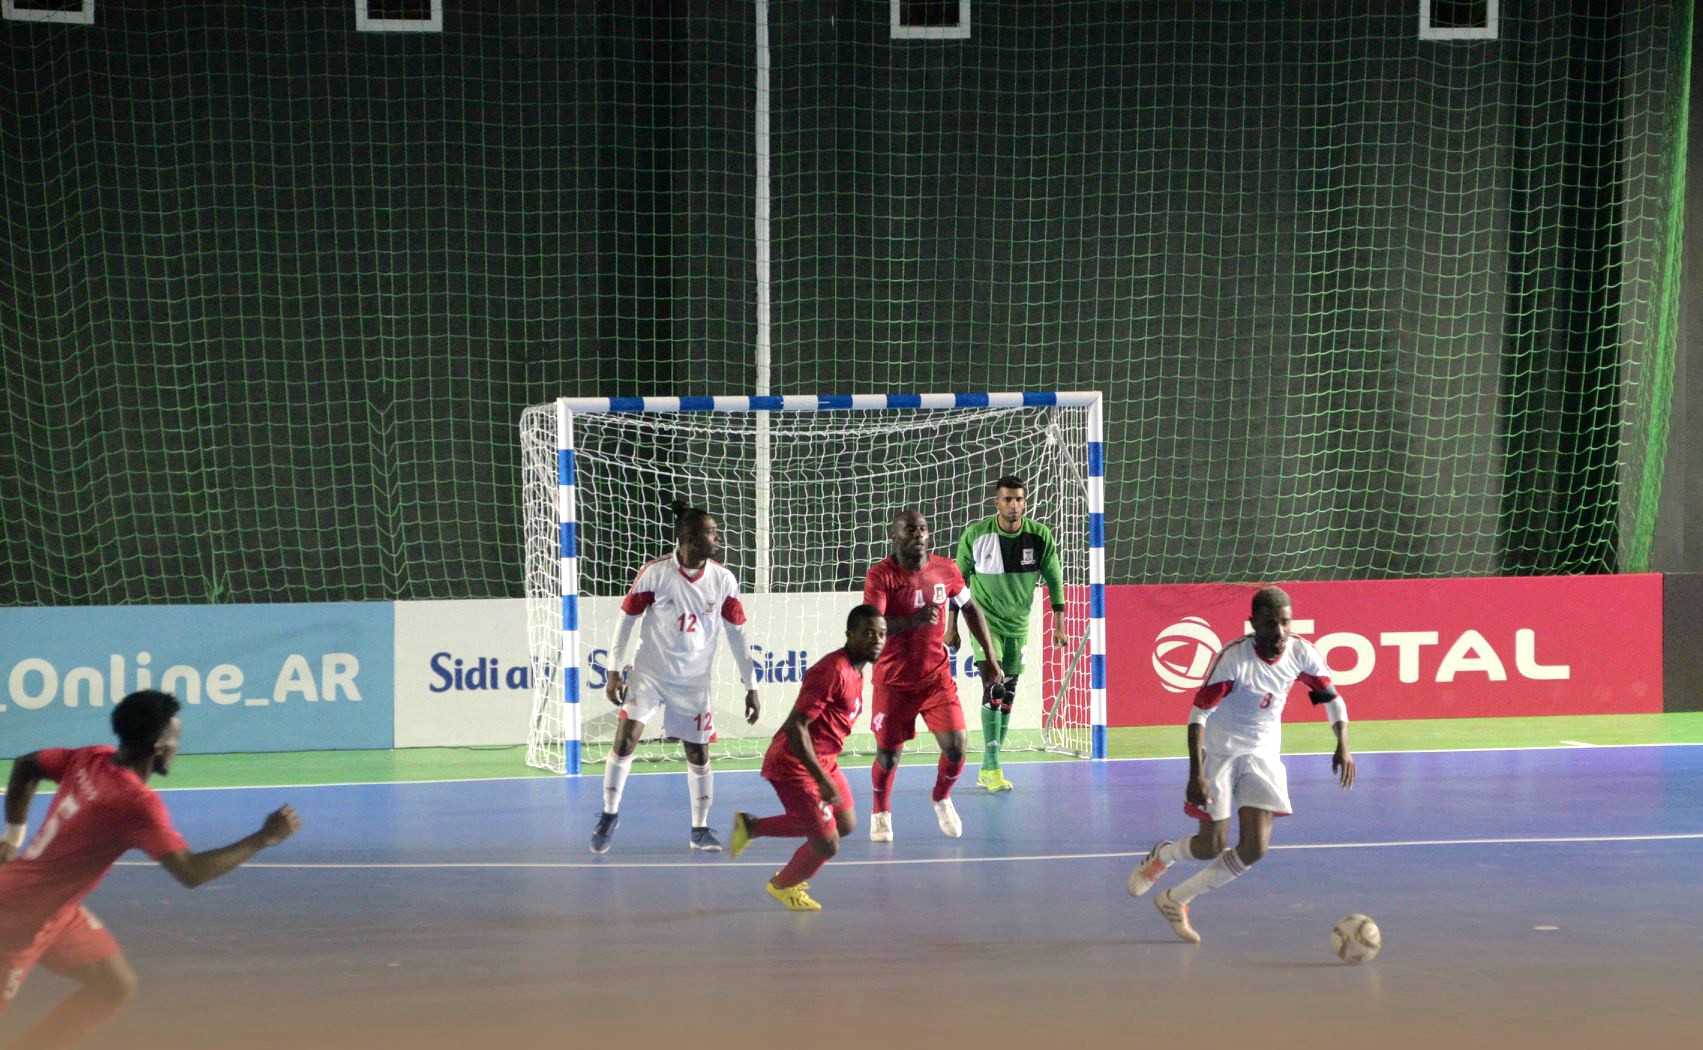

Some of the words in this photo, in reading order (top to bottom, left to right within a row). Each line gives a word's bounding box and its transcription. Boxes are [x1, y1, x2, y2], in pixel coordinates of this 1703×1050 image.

[677, 612, 698, 633] 12
[0, 651, 363, 714] Online_AR
[429, 651, 501, 694] Sidi
[1259, 691, 1274, 710] 8
[693, 711, 713, 732] 12
[872, 711, 886, 733] 4
